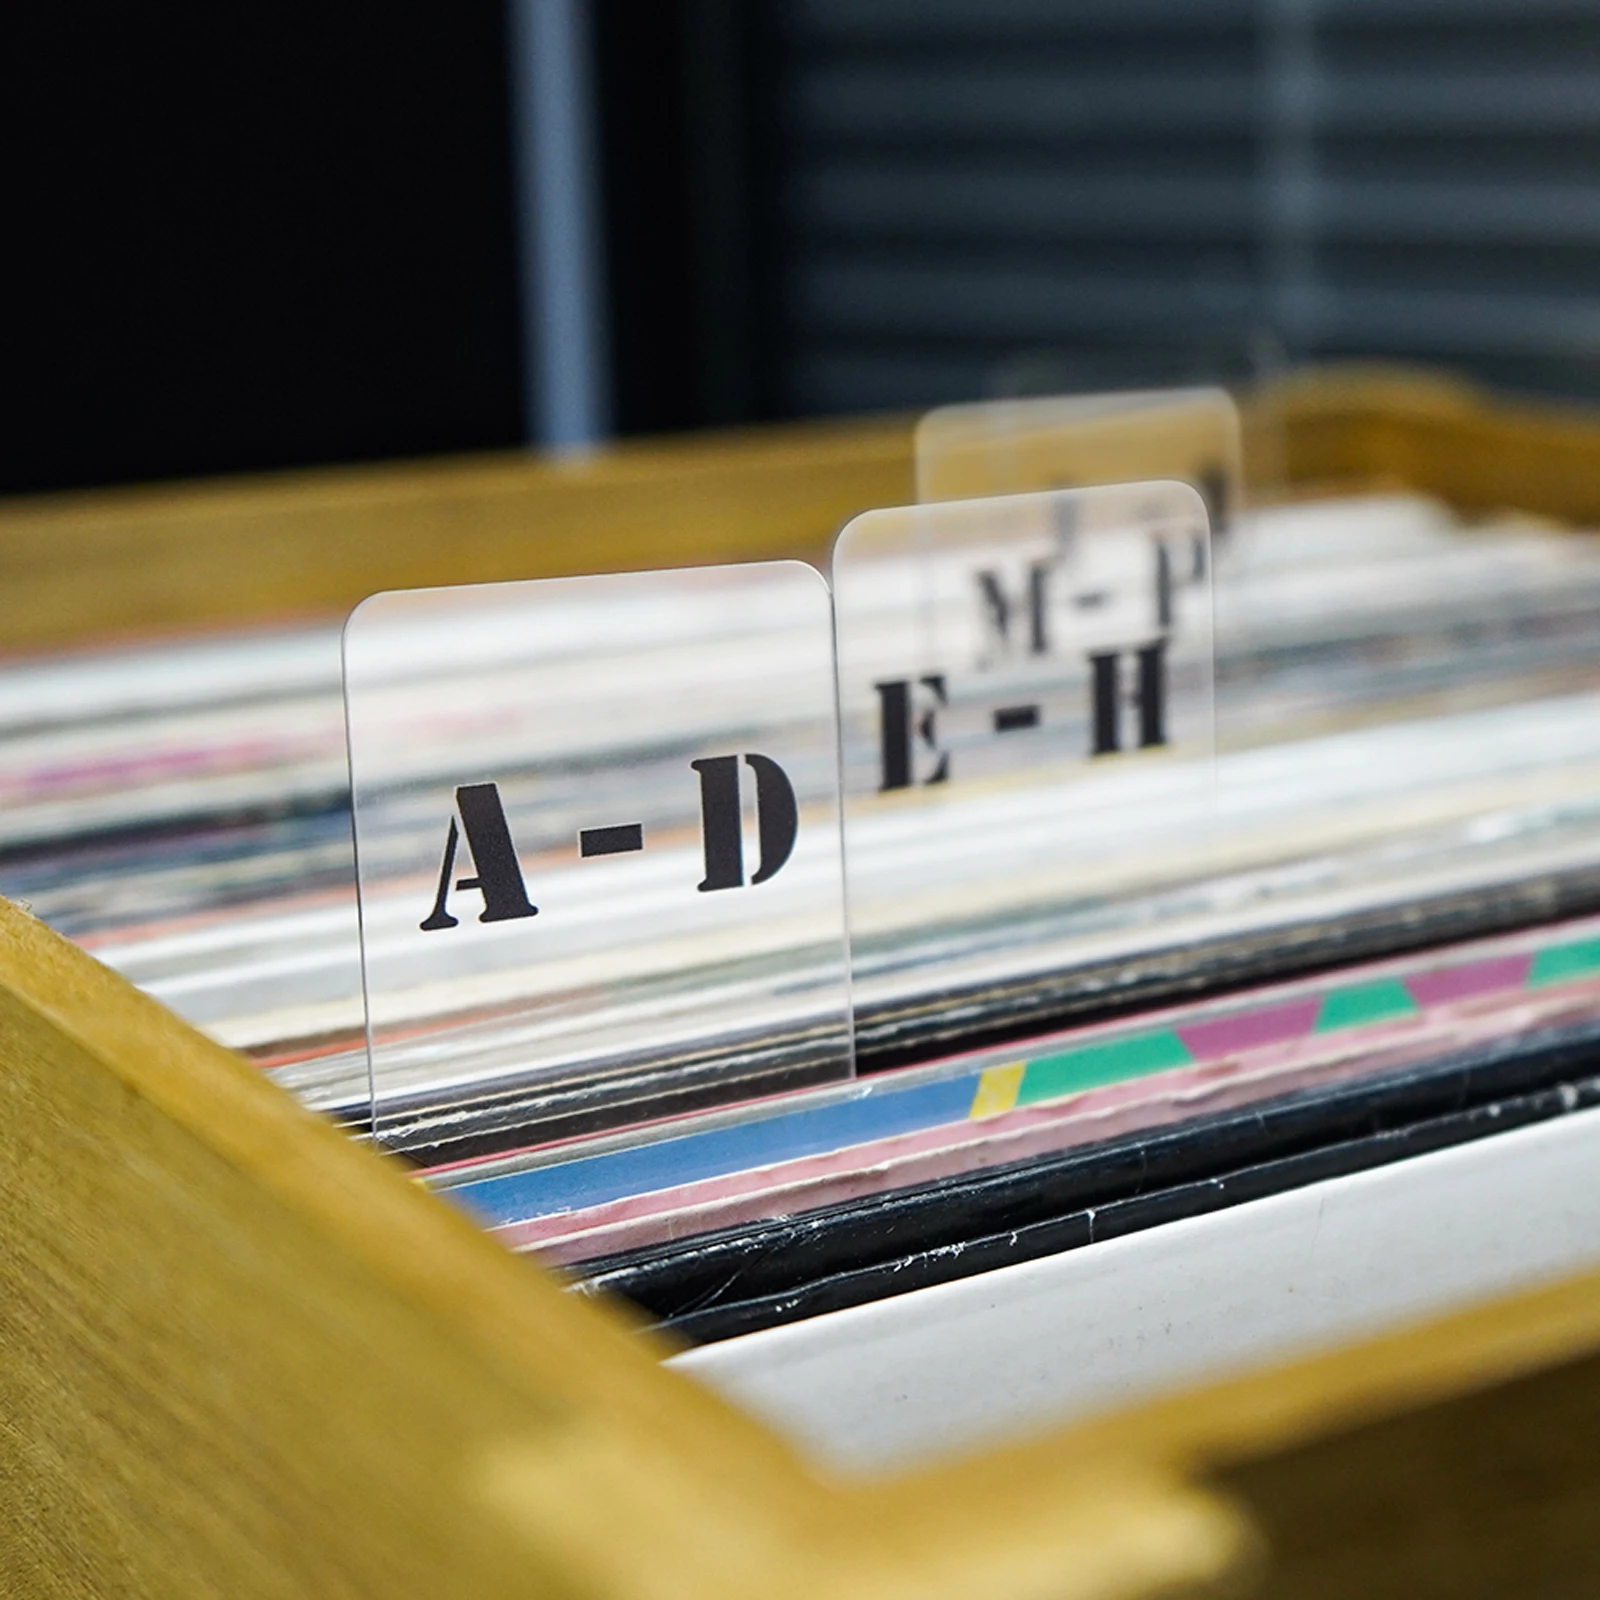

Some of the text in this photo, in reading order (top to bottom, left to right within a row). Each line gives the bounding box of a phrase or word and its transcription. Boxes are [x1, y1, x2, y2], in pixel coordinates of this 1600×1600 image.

[876, 675, 950, 793] E
[1088, 643, 1169, 757] H
[420, 753, 798, 931] A - D
